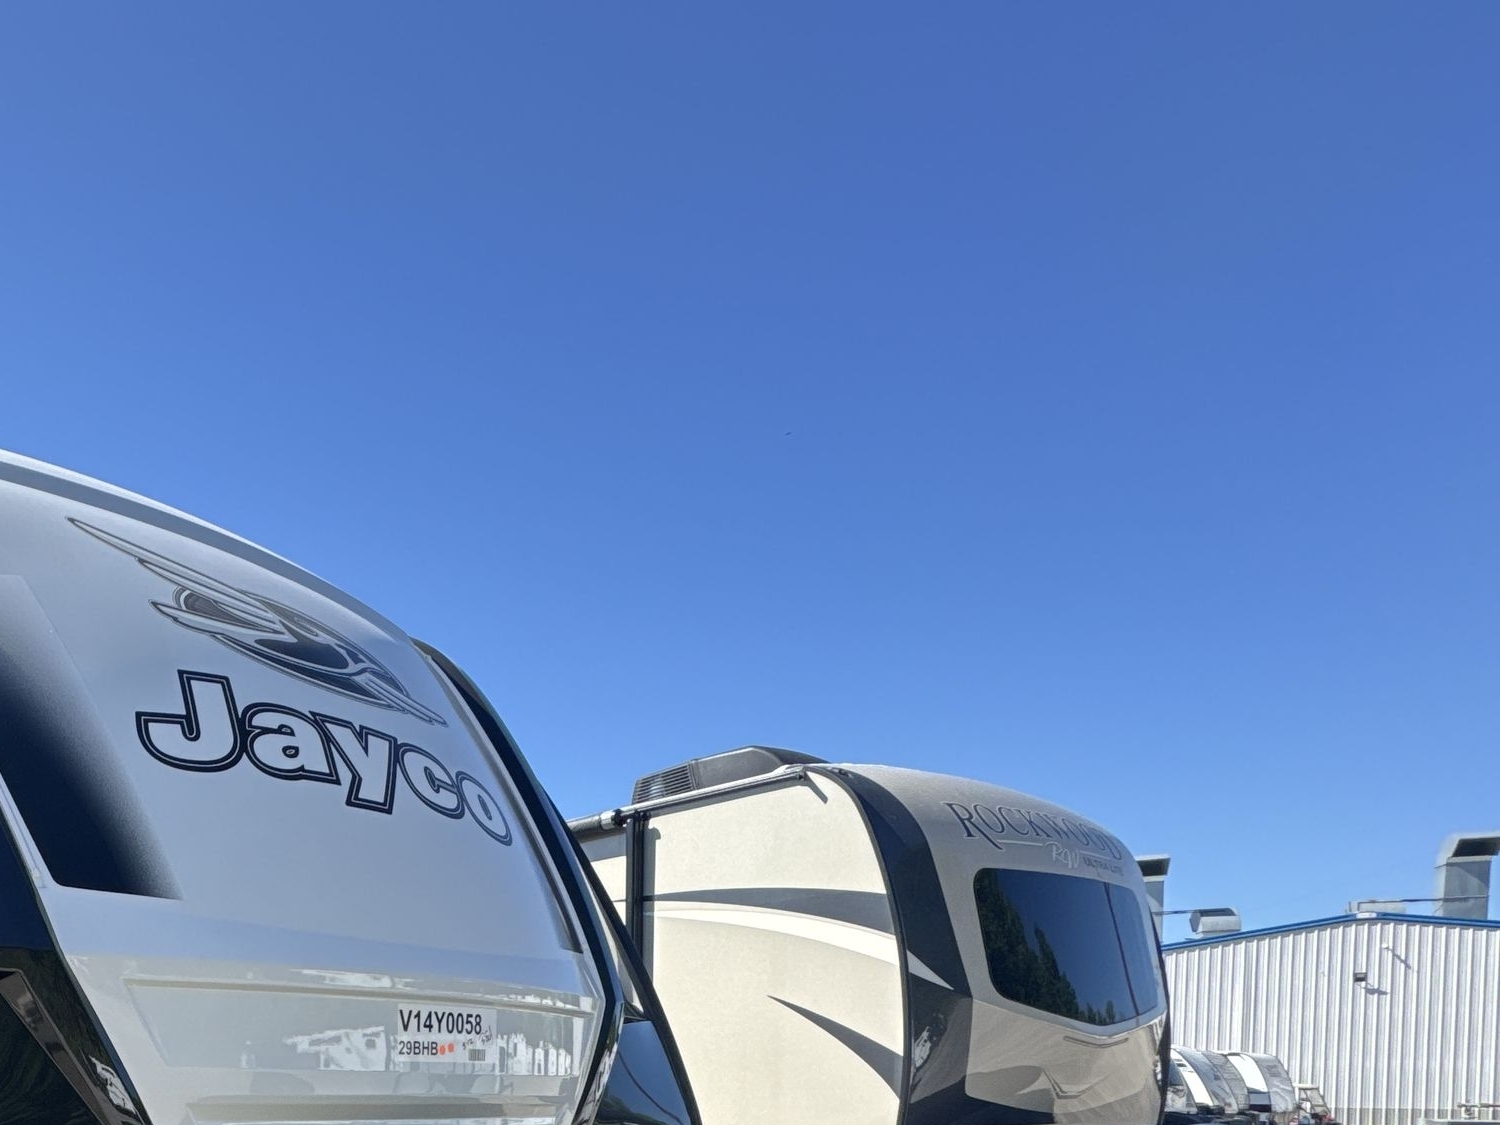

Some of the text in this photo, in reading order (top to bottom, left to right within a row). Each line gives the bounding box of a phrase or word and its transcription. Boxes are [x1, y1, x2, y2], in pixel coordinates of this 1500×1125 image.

[135, 669, 513, 847] Jayco
[941, 802, 1122, 861] ROCKWOOD
[399, 1009, 482, 1035] V14Y0058
[398, 1040, 438, 1056] 29BHB
